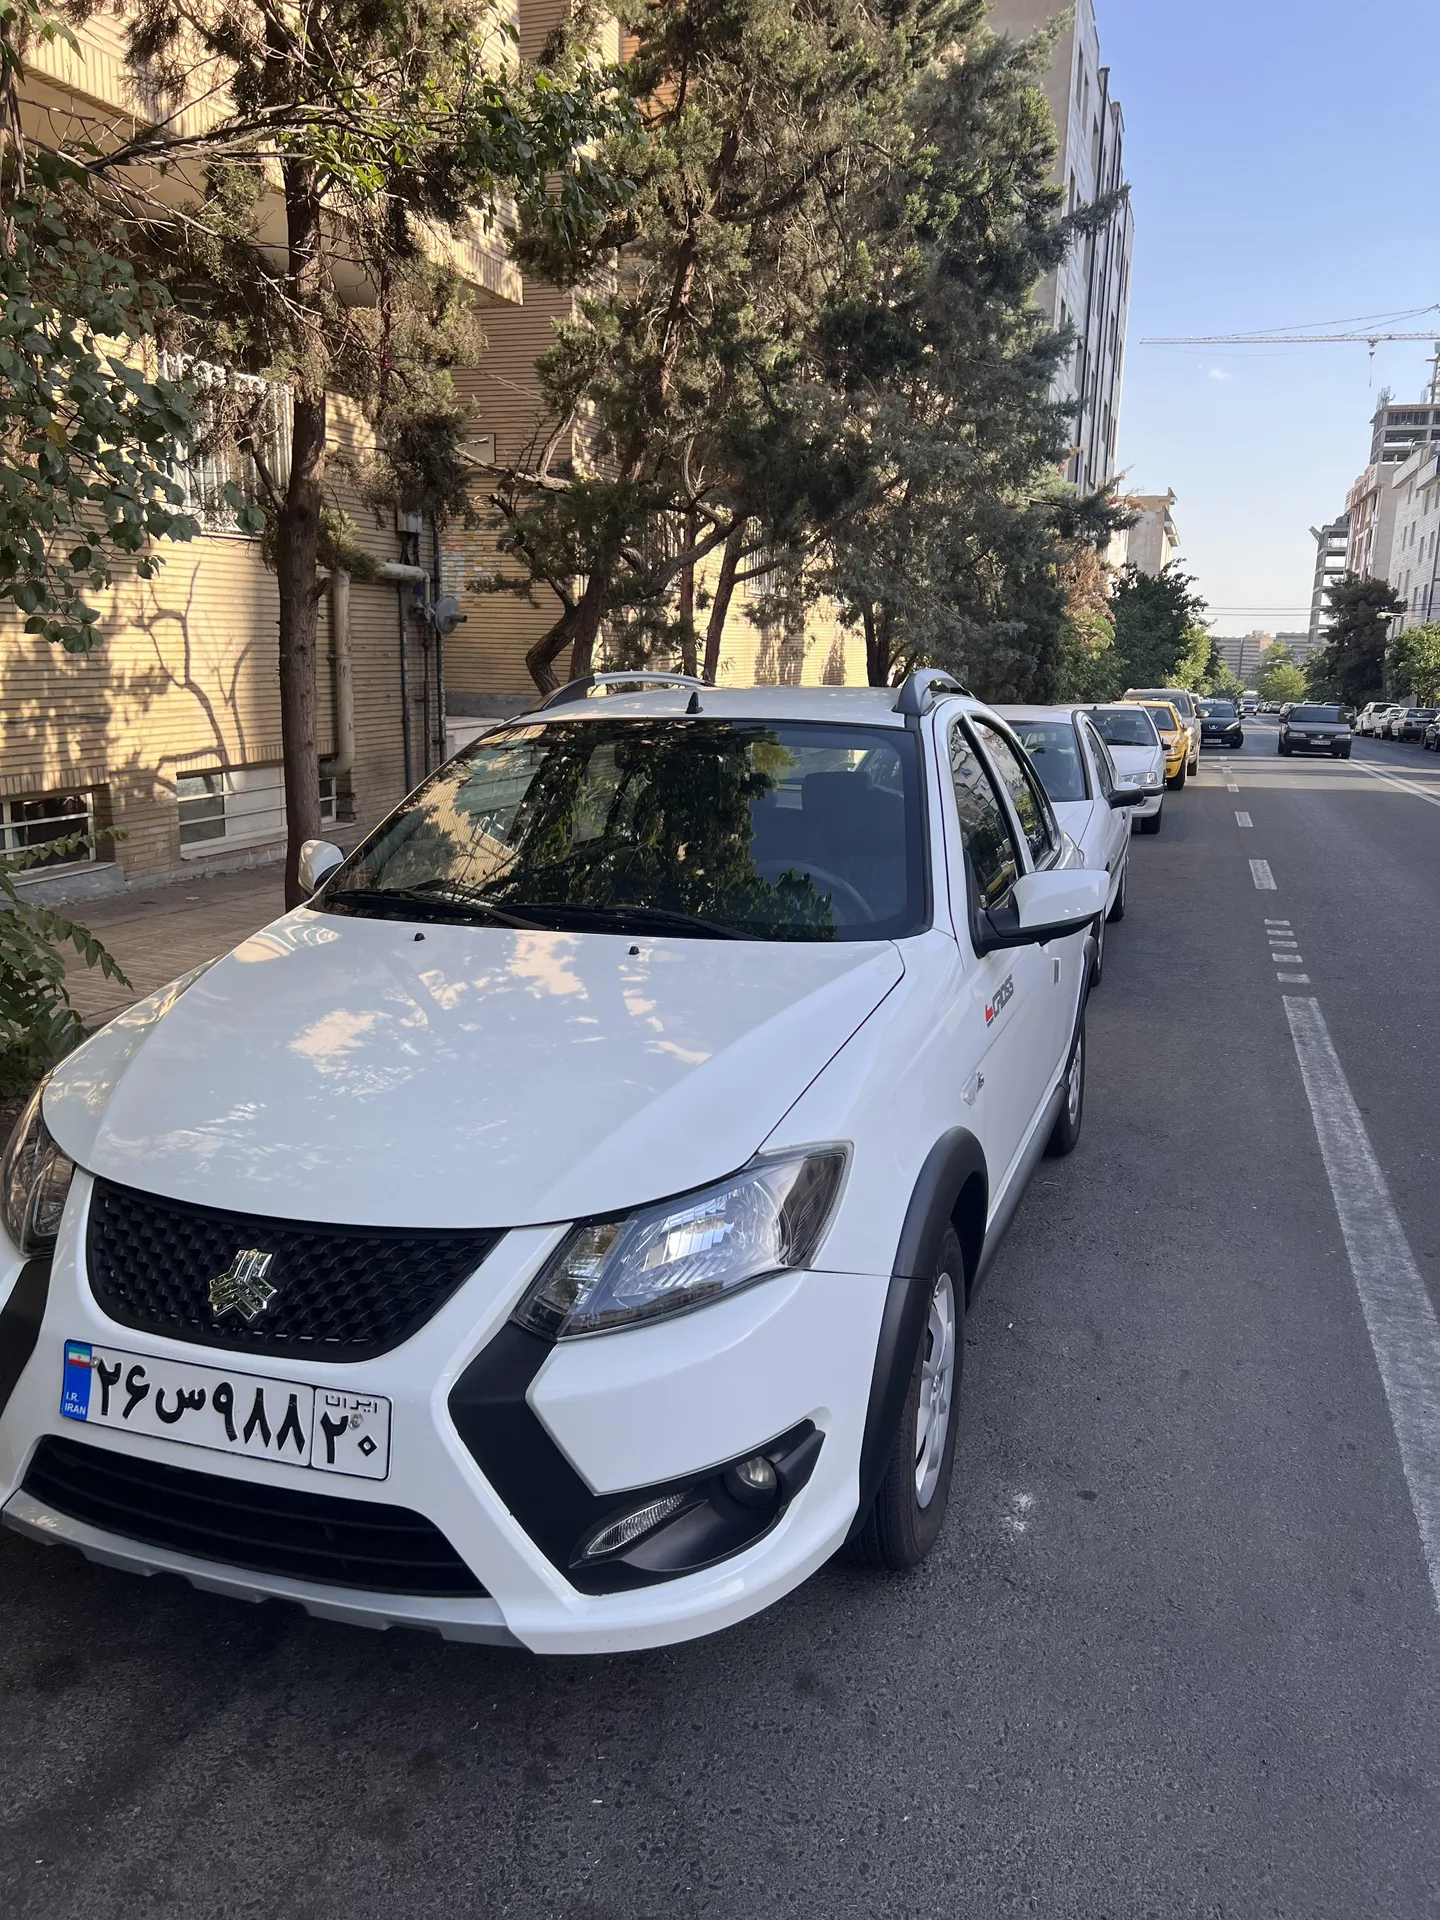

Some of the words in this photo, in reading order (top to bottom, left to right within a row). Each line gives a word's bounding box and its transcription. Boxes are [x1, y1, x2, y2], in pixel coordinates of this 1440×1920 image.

[65, 1402, 87, 1415] IRAN
[326, 1395, 377, 1413] ایران
[320, 1411, 378, 1465] ۲۰
